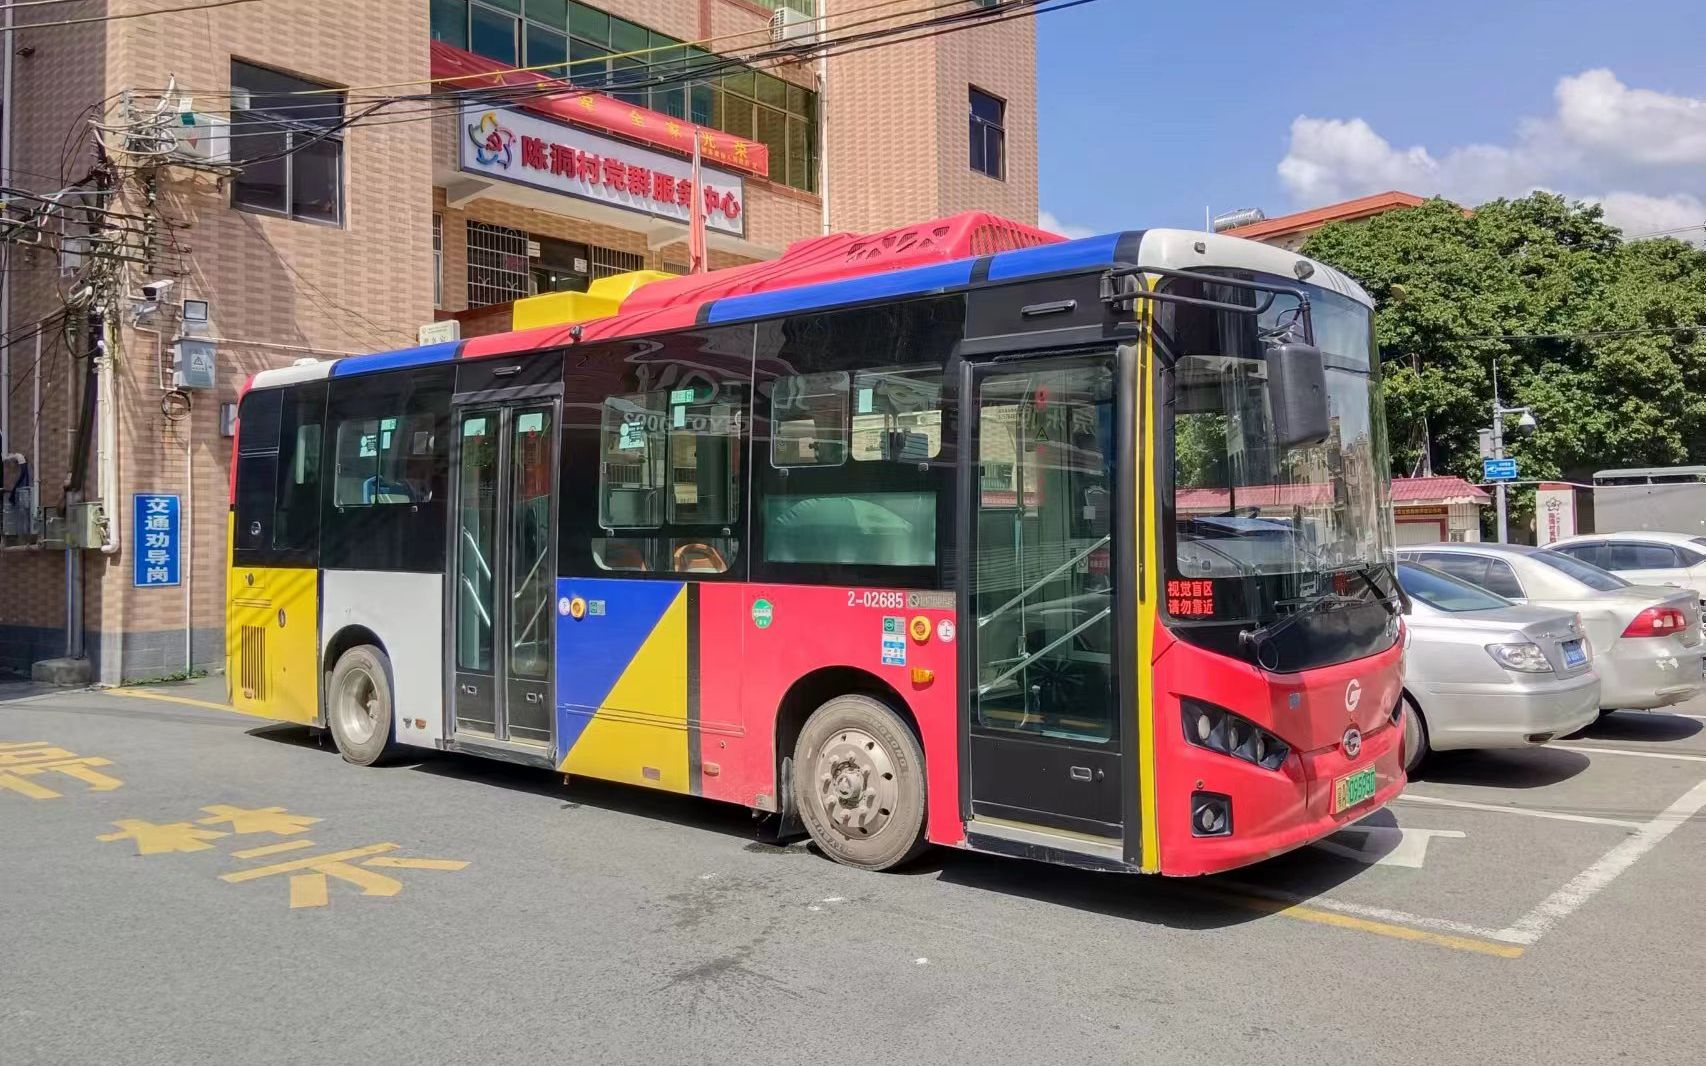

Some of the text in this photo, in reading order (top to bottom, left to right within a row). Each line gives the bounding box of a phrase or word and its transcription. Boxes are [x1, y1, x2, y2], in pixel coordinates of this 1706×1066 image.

[144, 497, 171, 583] 交通劝导岗
[1168, 580, 1213, 597] 视觉盲区
[847, 591, 904, 608] 2-02685
[1168, 598, 1214, 615] 请勿靠近
